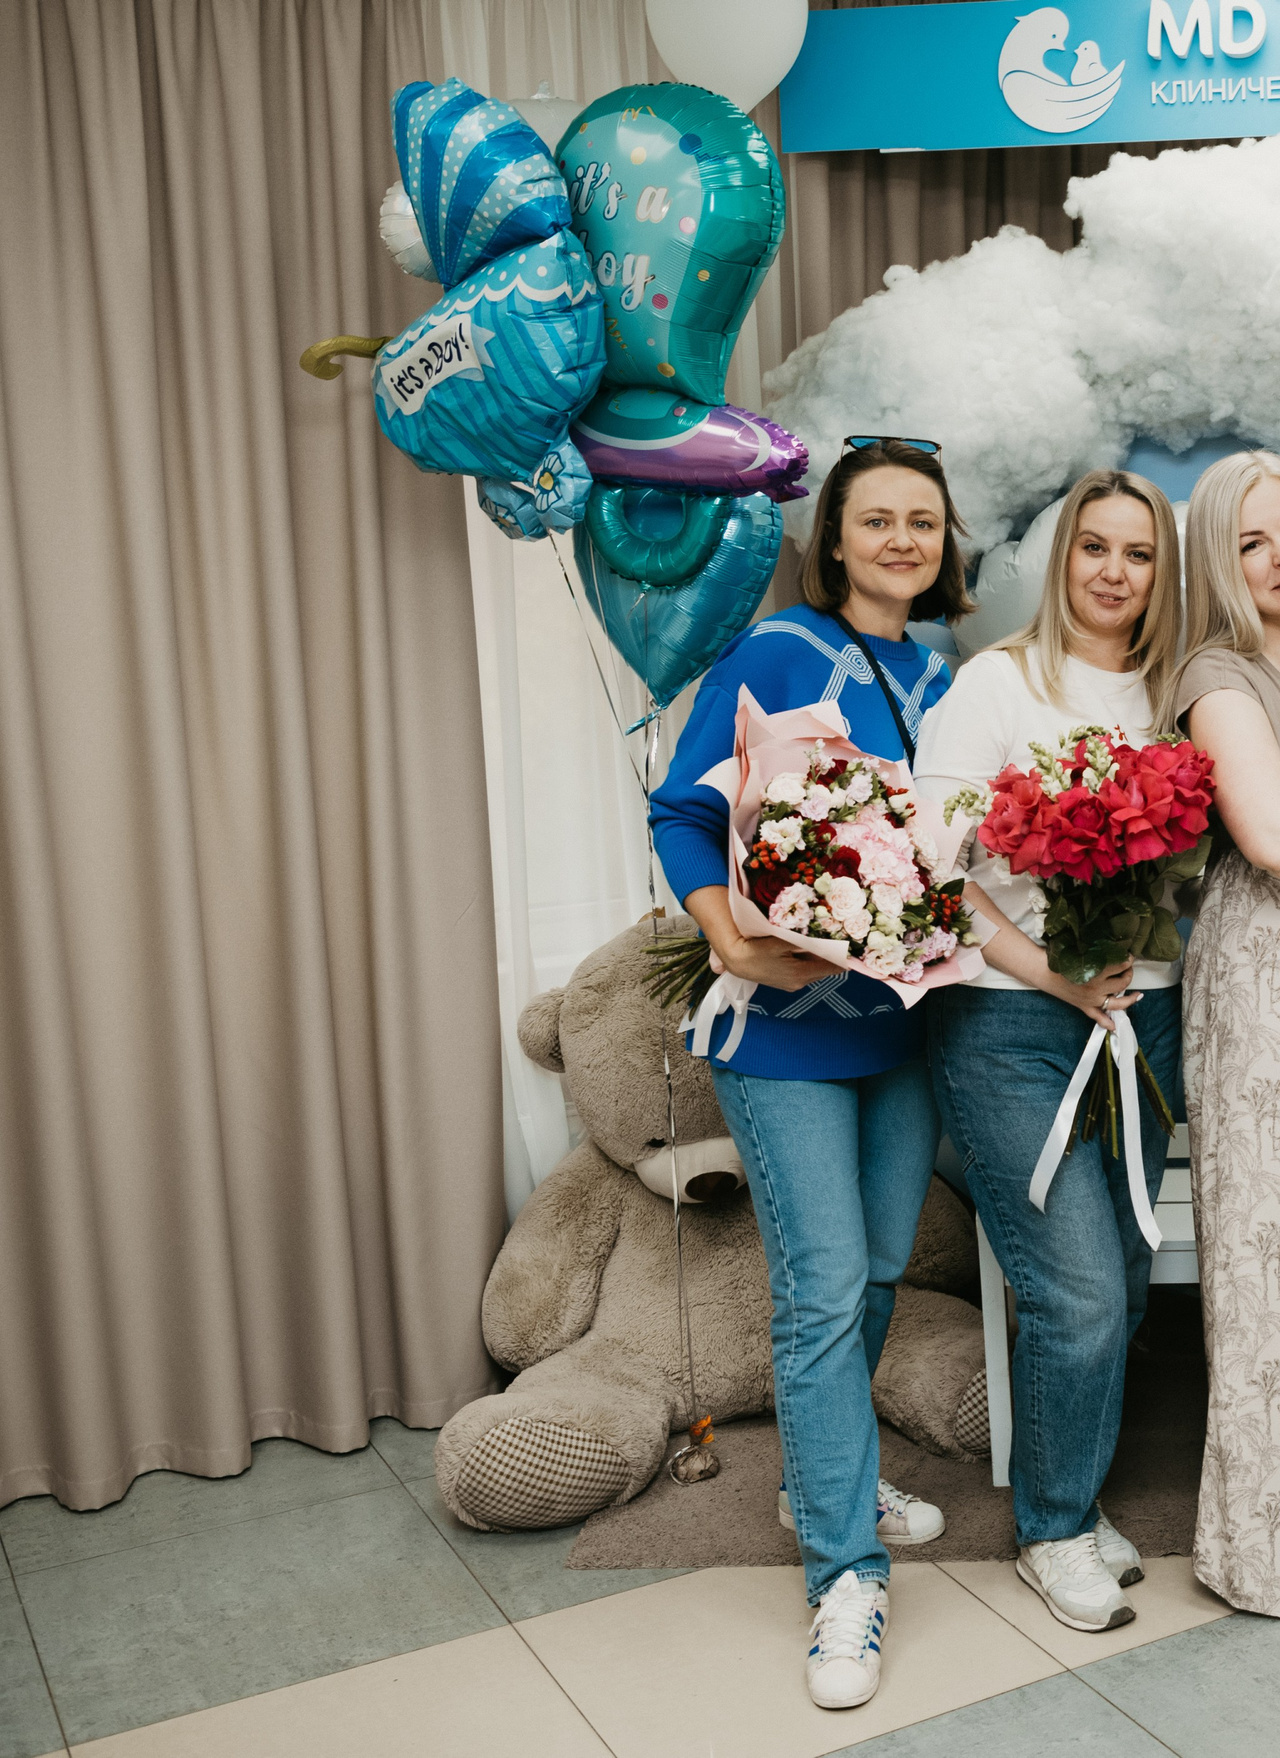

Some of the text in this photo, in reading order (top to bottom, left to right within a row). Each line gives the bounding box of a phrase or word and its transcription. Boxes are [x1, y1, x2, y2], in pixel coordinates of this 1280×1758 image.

[1147, 0, 1266, 60] MD
[570, 161, 671, 223] it's a
[419, 358, 433, 380] a
